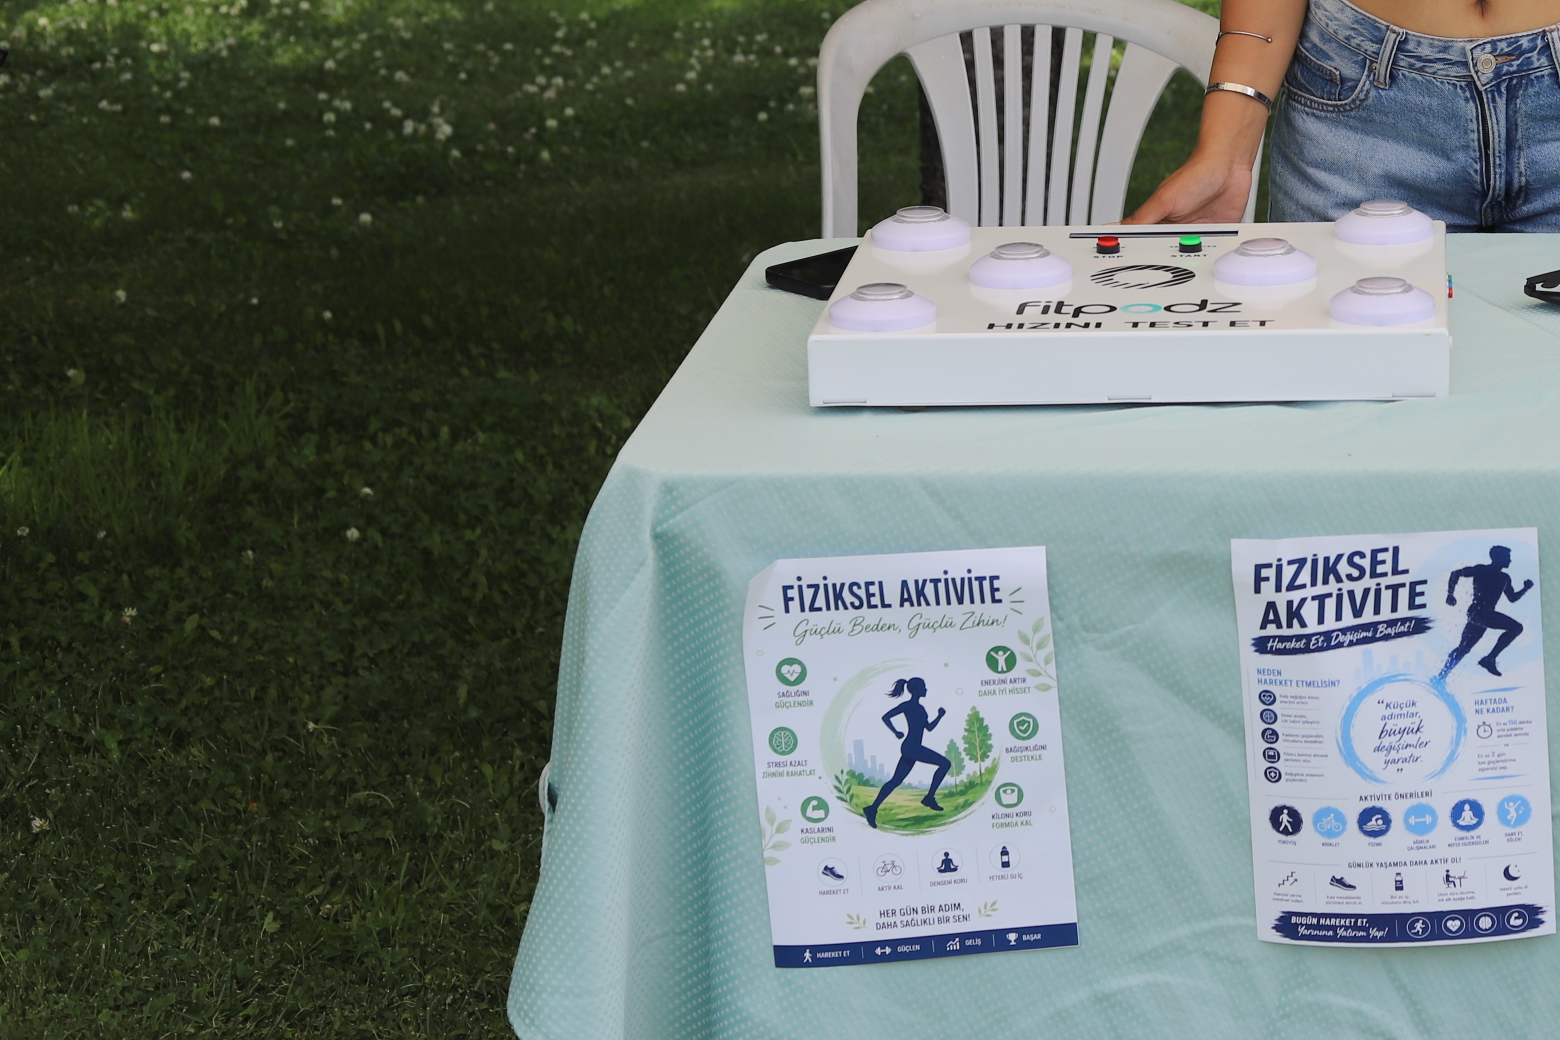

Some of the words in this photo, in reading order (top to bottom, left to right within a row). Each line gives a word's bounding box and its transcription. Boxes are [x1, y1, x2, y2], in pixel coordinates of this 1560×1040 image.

[1015, 299, 1243, 318] fitpodz
[987, 321, 1103, 330] HIZINI
[1125, 320, 1217, 329] TEST
[1229, 320, 1275, 328] ET
[1254, 545, 1410, 594] FİZİKSEL
[782, 575, 892, 614] FİZİKSEL
[900, 568, 1003, 608] AKTİVİTE
[1259, 580, 1428, 630] AKTİVİTE
[793, 619, 844, 646] Güçlü
[848, 616, 902, 637] Beden,
[907, 613, 957, 640] Güçlü
[959, 611, 1008, 631] Zihin!
[1267, 638, 1306, 651] Hareket
[1310, 635, 1327, 649] Et,
[1330, 630, 1374, 648] Değişimi
[1377, 620, 1415, 638] Başlat!
[1256, 668, 1282, 676] NEDEN
[981, 678, 1008, 686] ENERJİNİ
[1258, 678, 1293, 688] HAREKET
[1296, 678, 1340, 688] ETMELİSİN?
[777, 688, 810, 698] SAĞLIĞINI
[978, 690, 996, 698] DAHA
[998, 688, 1007, 696] İYİ
[1008, 686, 1031, 696] HİSSET
[775, 698, 814, 710] GÜÇLENDİR
[1474, 698, 1508, 706] HAFTADA
[1486, 706, 1514, 714] KADAR?
[1380, 711, 1421, 722] adımlar,
[1378, 719, 1424, 744] büyük
[1005, 744, 1047, 754] BAĞIŞIKLIĞINI
[1373, 737, 1432, 758] değişimler
[1010, 754, 1042, 762] DESTEKLE
[1382, 753, 1423, 771] yaratır.
[766, 760, 788, 768] STRESİ
[789, 760, 808, 768] AZALT
[762, 769, 785, 779] ZİHNİNİ
[786, 769, 816, 778] RAHATLAT
[1359, 792, 1392, 802] AKTİVİTE
[1394, 789, 1432, 802] ÖNERİLERİ
[992, 812, 1014, 820] KİLONU
[800, 826, 834, 834] KASLARINI
[992, 822, 1019, 830] FORMDA
[800, 835, 836, 846] GÜÇLENDİR
[1348, 861, 1374, 869] GÜNLÜK
[1376, 861, 1408, 870] YAŞAMDA
[1430, 857, 1448, 866] AKTİF
[879, 907, 898, 919] HER
[899, 905, 918, 918] GÜN
[920, 903, 936, 916] BİR
[938, 902, 965, 914] ADIM,
[875, 920, 898, 930] DAHA
[900, 917, 936, 930] SAĞLIKLI
[938, 914, 950, 926] BİR
[952, 914, 971, 924] SEN!
[1291, 915, 1318, 925] BUGÜN
[1320, 917, 1354, 926] HAREKET
[1358, 918, 1369, 928] ET,
[1022, 932, 1042, 942] BAŞAR
[1298, 925, 1334, 936] Yarınına
[1336, 927, 1367, 938] Yatırım
[1369, 926, 1388, 940] Yap!
[965, 937, 982, 947] GELİŞ
[897, 943, 920, 953] GÜÇLEN
[816, 950, 842, 959] HAREKET
[842, 950, 850, 958] ET
